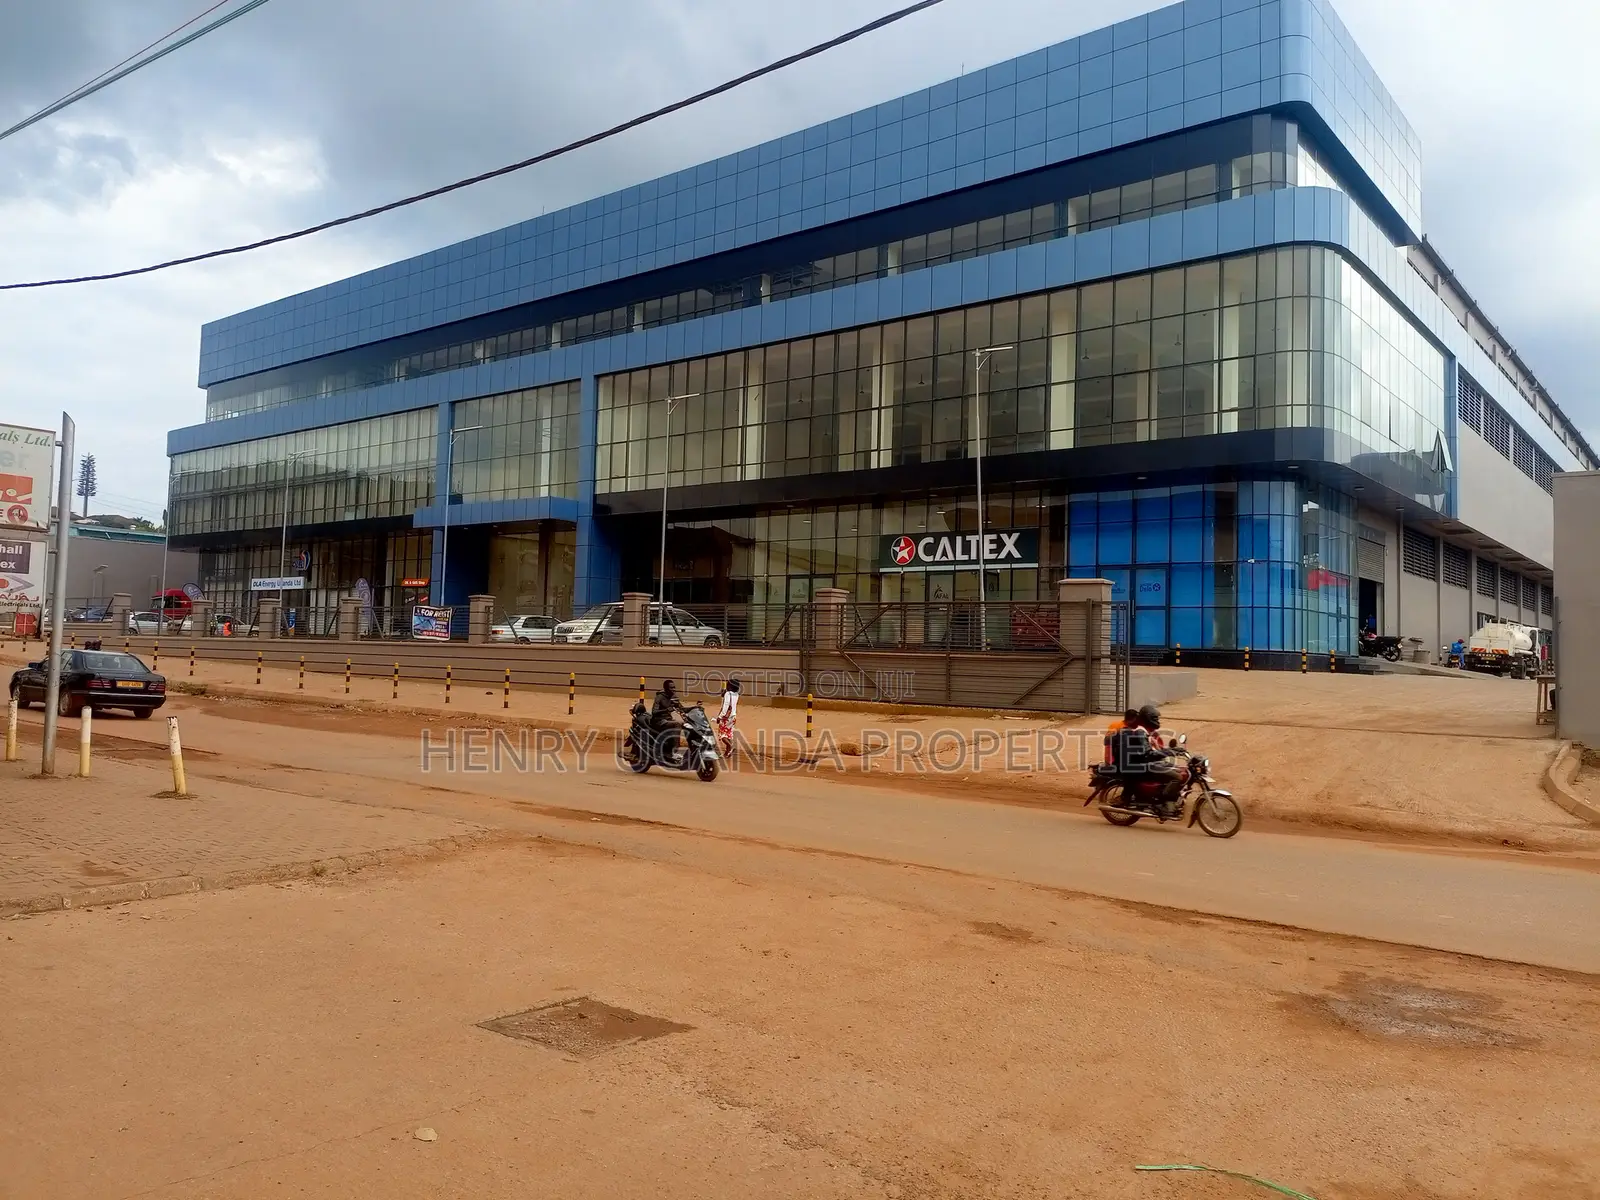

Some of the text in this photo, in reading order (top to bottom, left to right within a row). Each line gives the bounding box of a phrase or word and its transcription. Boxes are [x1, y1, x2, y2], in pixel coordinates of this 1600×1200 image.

[0, 431, 51, 447] als Ltd.
[917, 532, 1023, 563] CALTEX
[262, 580, 276, 588] Energy
[421, 608, 434, 617] FOR
